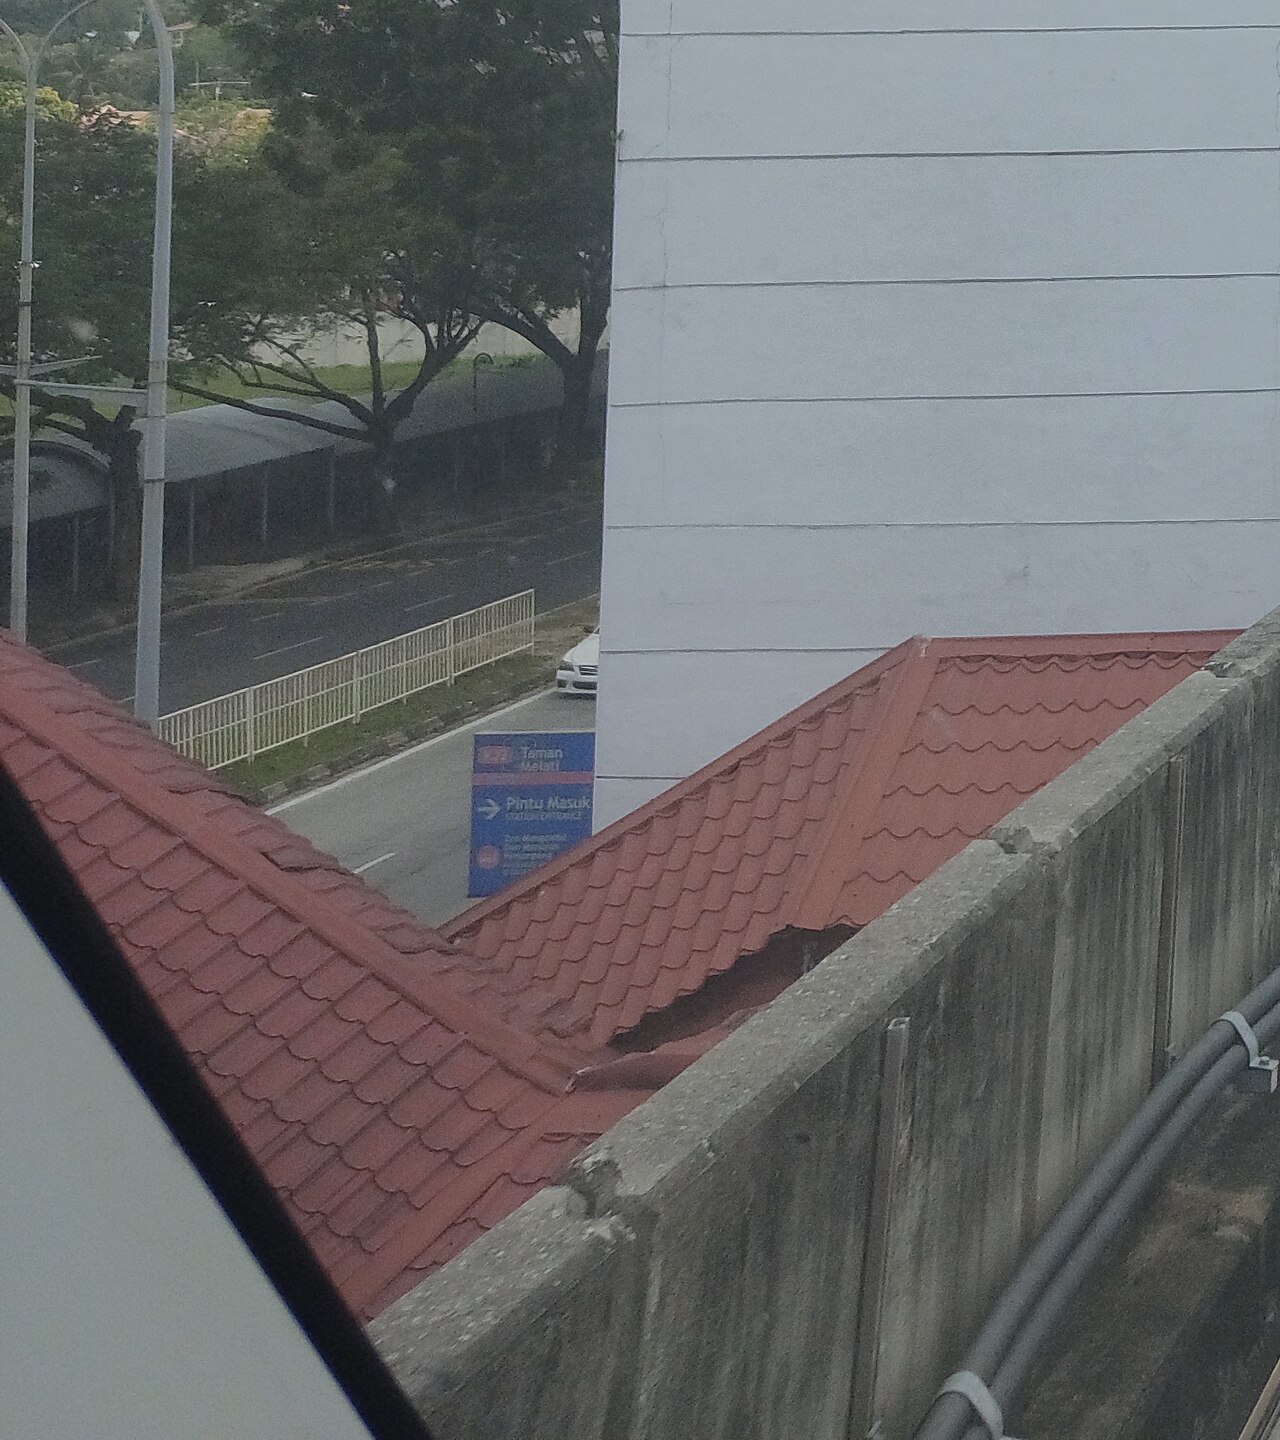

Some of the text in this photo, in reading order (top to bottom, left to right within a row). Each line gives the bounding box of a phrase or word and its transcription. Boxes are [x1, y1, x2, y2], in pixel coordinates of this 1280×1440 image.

[521, 746, 563, 759] Taman
[506, 796, 590, 809] Pintu Masuk
